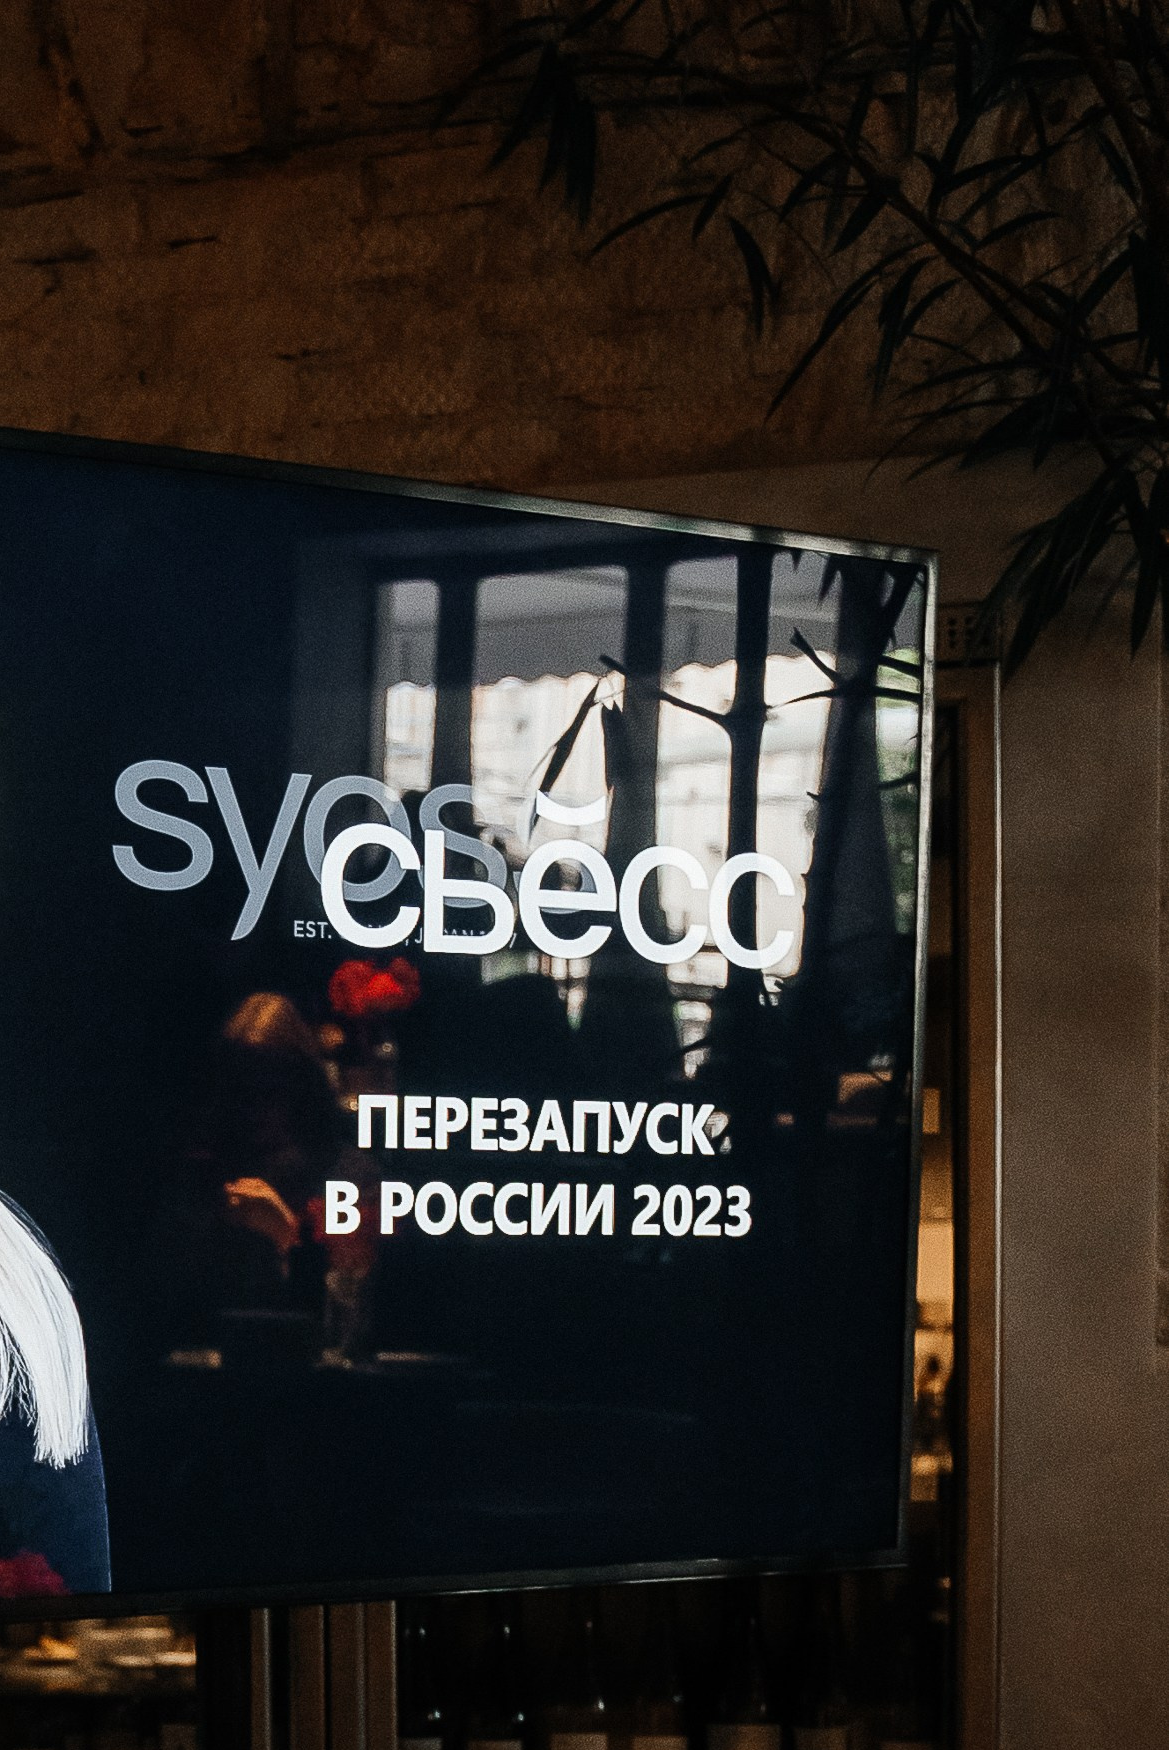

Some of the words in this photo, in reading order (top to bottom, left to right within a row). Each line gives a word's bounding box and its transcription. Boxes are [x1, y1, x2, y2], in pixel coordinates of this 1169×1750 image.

[293, 919, 332, 940] EST.
[357, 1094, 716, 1156] ПЕРЕЗАПУСК
[325, 1180, 361, 1235] В
[380, 1180, 615, 1236] РОССИИ
[631, 1184, 753, 1237] 2023
